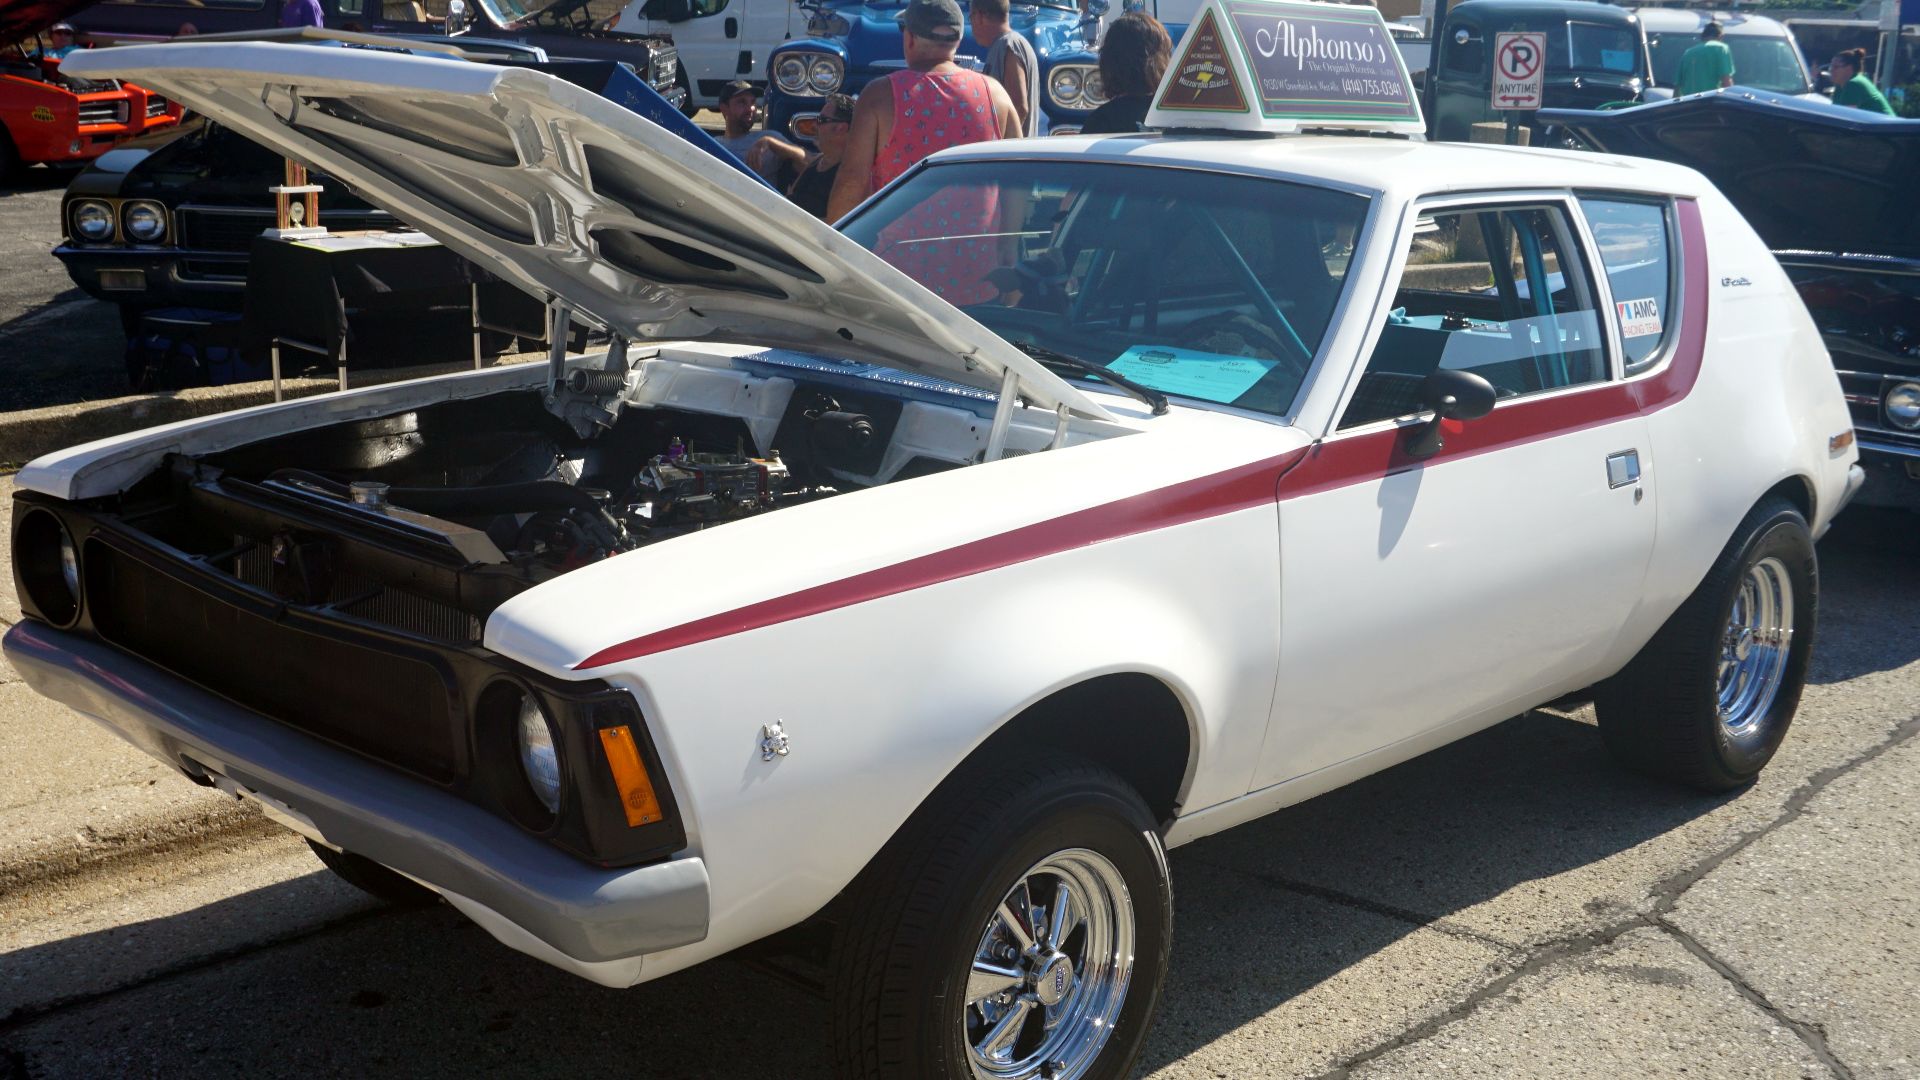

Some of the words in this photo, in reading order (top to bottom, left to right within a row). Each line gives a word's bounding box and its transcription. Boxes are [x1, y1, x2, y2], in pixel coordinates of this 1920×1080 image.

[1255, 20, 1386, 70] Alphonso's
[1183, 63, 1213, 75] LIGHTNING
[1306, 61, 1321, 71] The
[1322, 62, 1350, 75] Original
[1341, 78, 1363, 96] (414)
[1498, 83, 1536, 94] ANYTIME
[1633, 299, 1657, 319] AMC
[1624, 324, 1645, 337] RACING
[1645, 321, 1661, 333] TEAM
